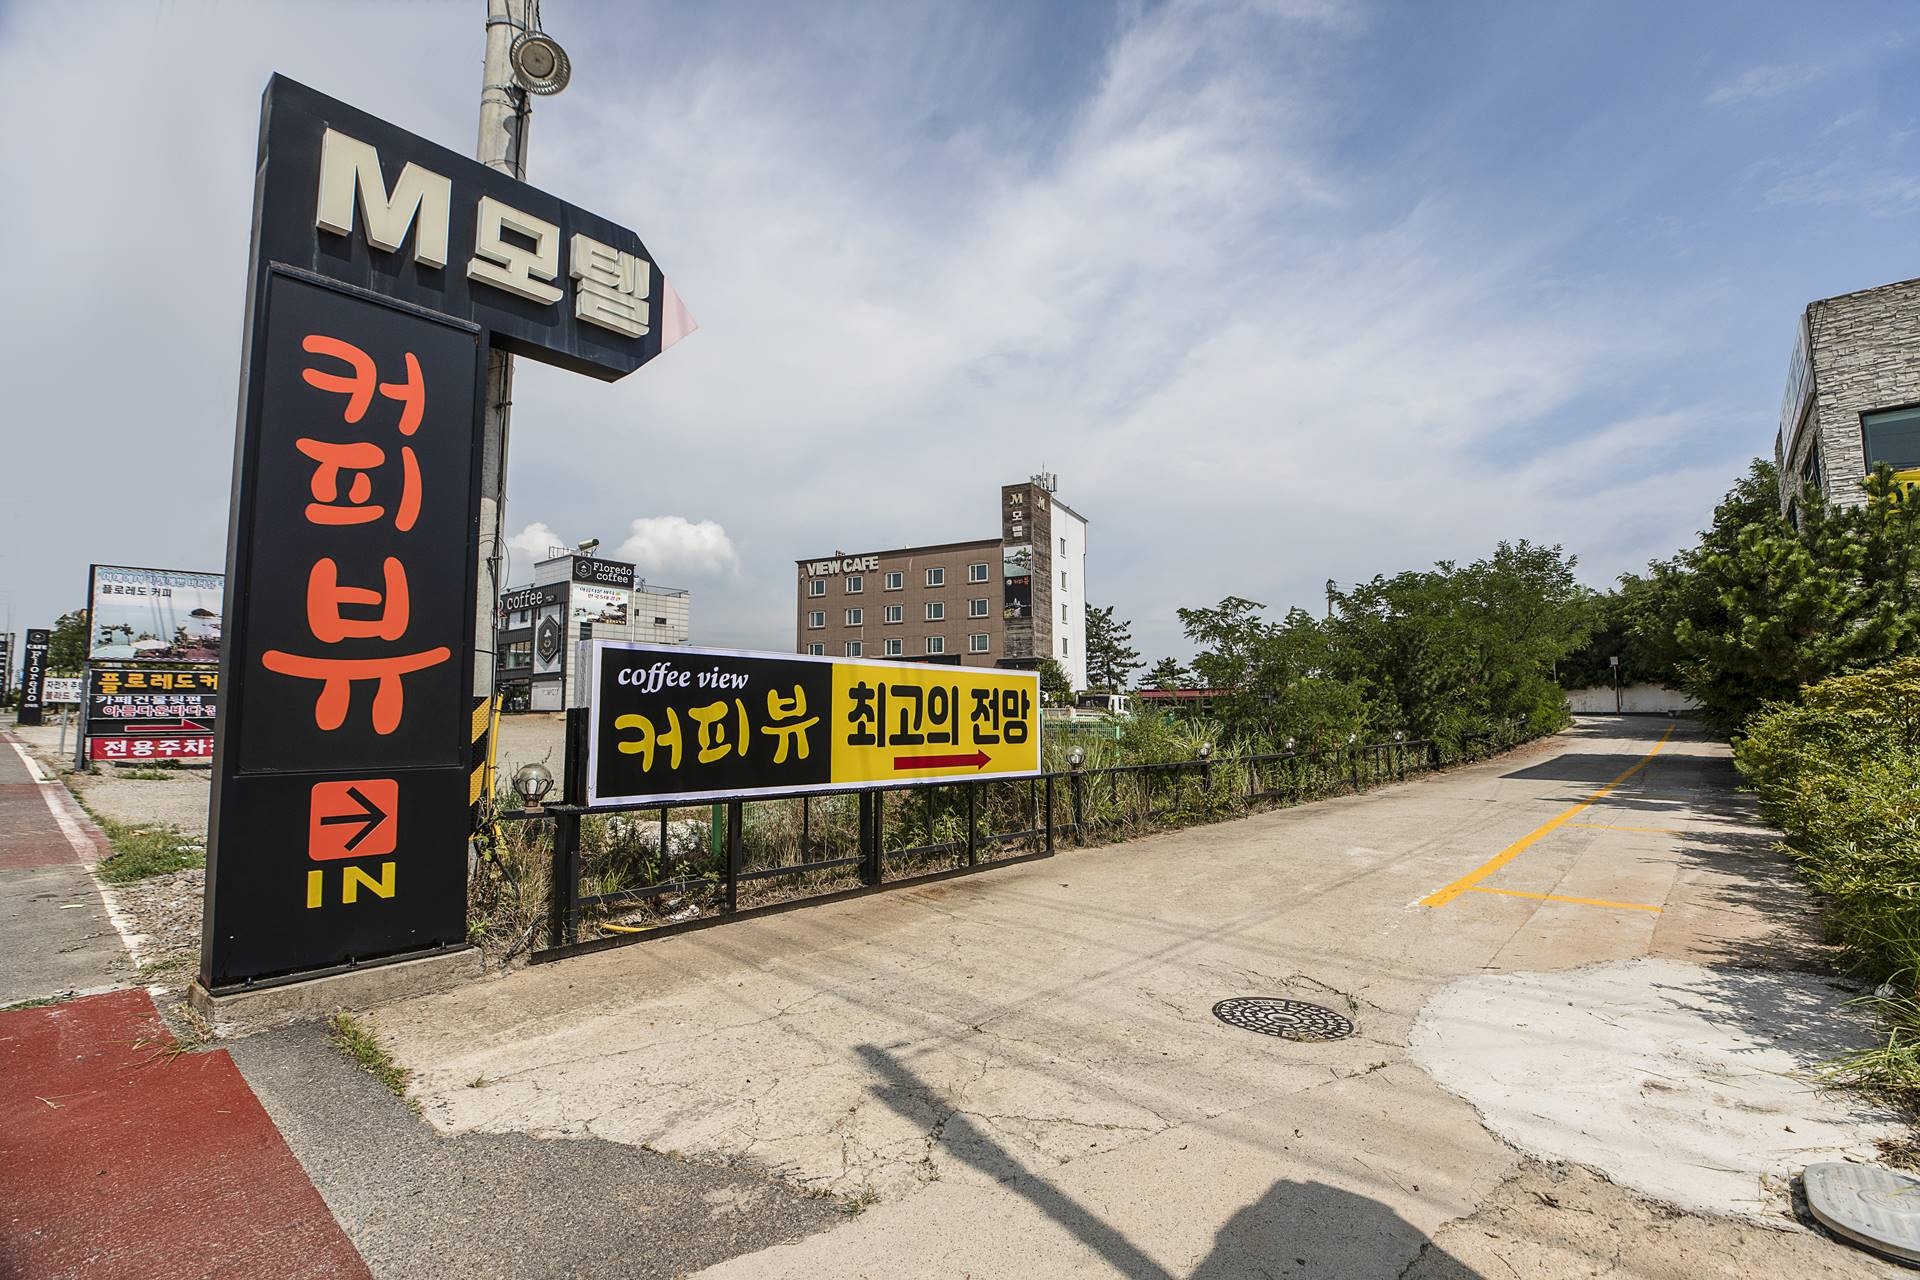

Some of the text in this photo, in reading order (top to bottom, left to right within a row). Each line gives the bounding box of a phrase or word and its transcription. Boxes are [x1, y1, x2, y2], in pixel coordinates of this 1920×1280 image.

[261, 335, 452, 736] 커피뷰
[593, 561, 632, 576] Floredo
[806, 556, 879, 576] VIEW CAFE
[102, 584, 172, 598] 플로레도 커피
[506, 590, 543, 610] coffee
[617, 662, 749, 694] coffee view
[846, 681, 1031, 748] 최고의 전망
[306, 861, 396, 908] IN
